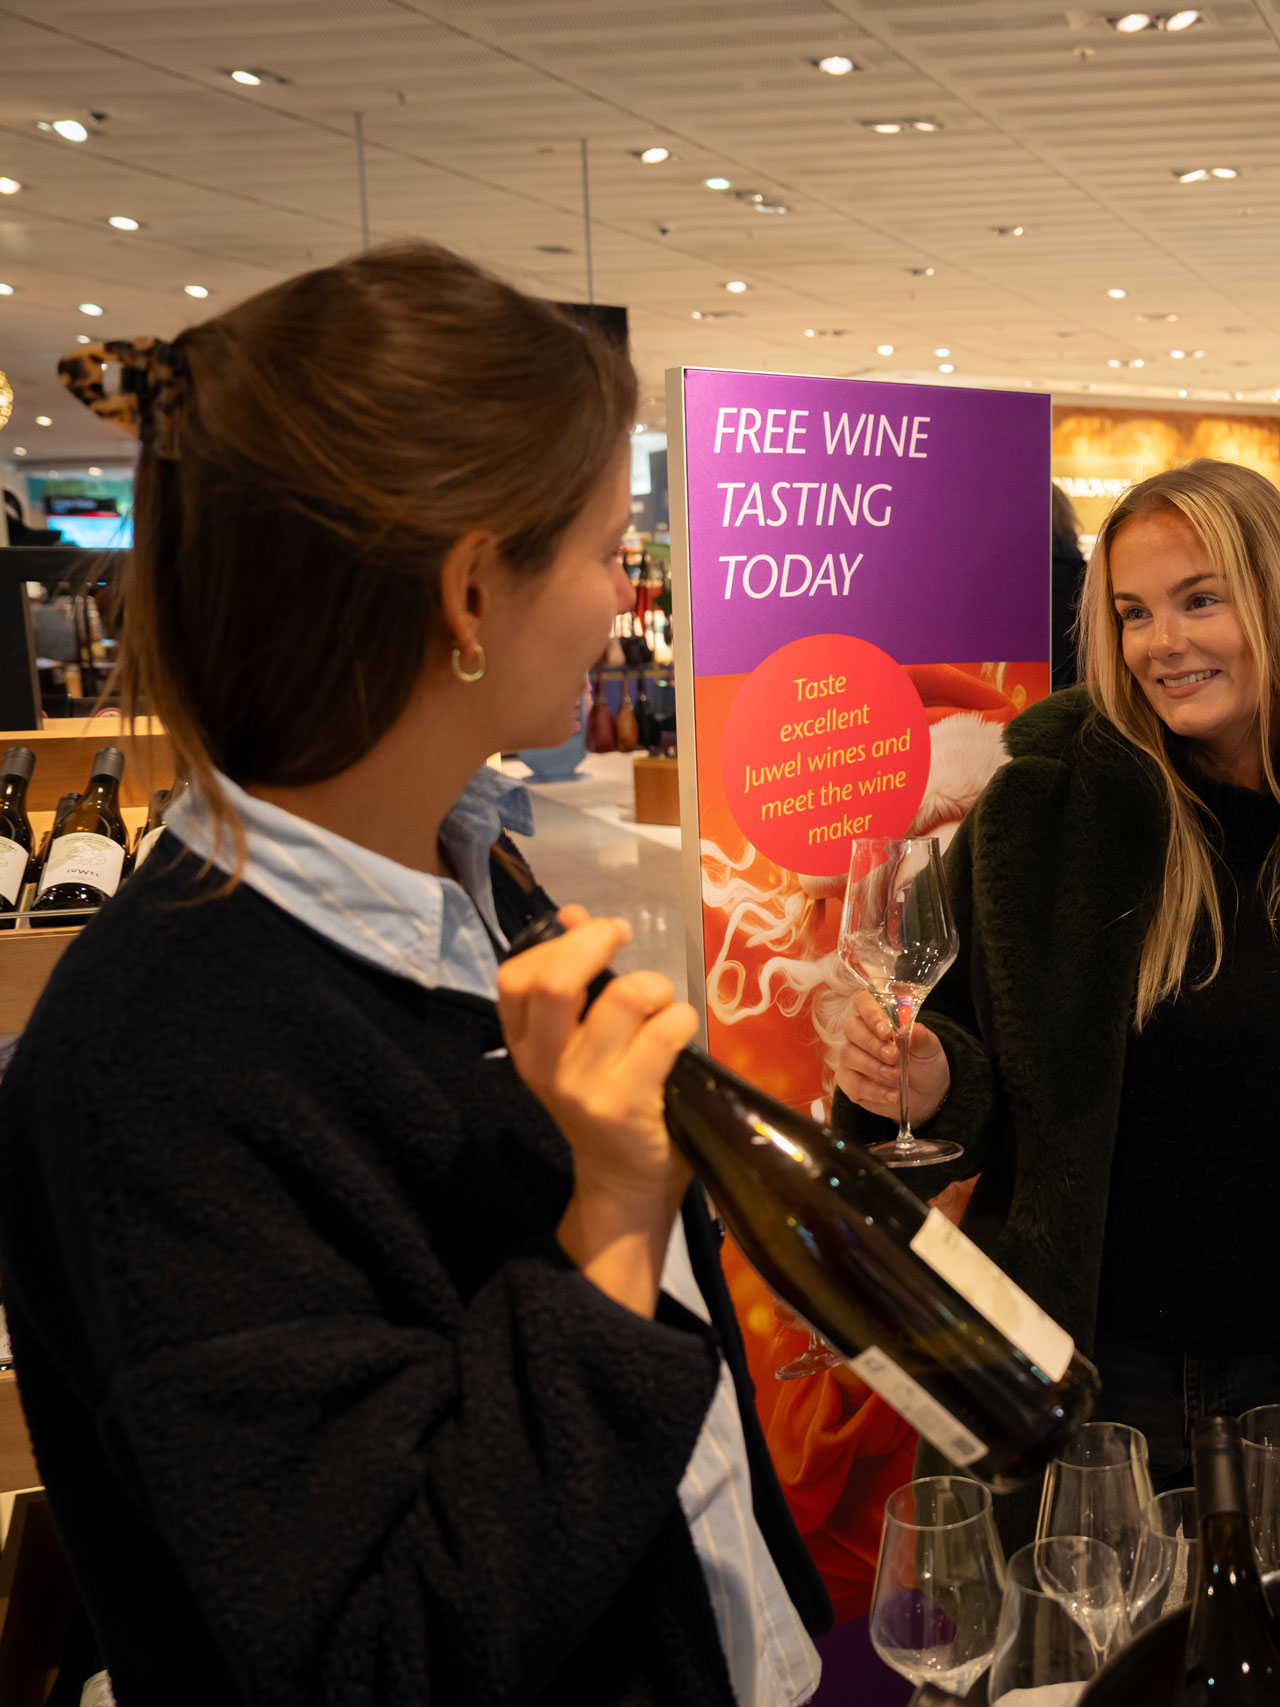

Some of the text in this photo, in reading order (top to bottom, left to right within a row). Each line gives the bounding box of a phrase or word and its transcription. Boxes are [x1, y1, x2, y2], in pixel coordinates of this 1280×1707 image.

[714, 407, 931, 458] FREE WINE
[717, 481, 893, 527] TASTING
[718, 553, 864, 599] TODAY
[794, 674, 847, 702] Taste
[780, 704, 870, 742] excellent
[744, 728, 911, 794] Juwel wines and
[761, 770, 907, 821] meet the wine
[808, 814, 873, 846] maker
